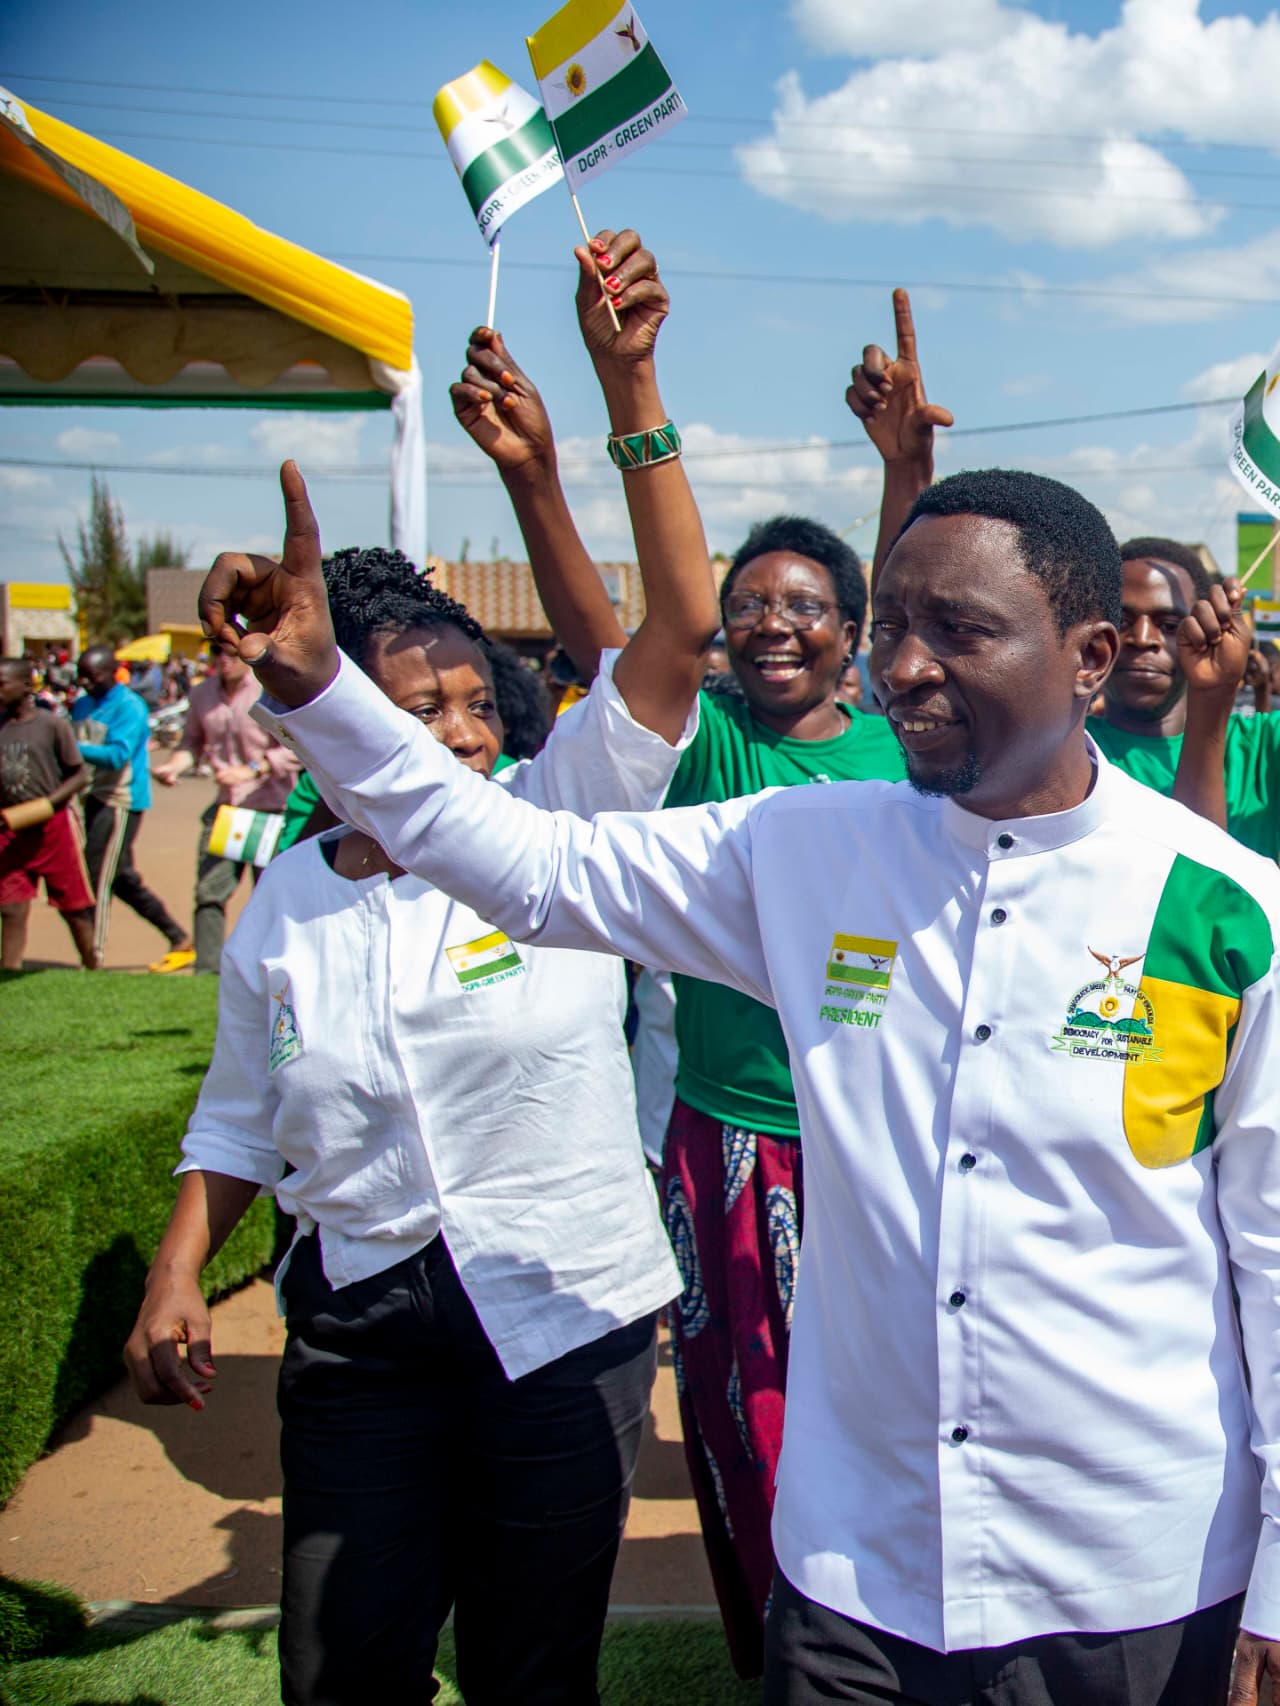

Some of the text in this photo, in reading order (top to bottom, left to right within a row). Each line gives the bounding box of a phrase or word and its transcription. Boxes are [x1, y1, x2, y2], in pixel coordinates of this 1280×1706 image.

[578, 144, 608, 173] DGPR
[615, 117, 654, 149] GREEN
[820, 1004, 882, 1028] PRESIDENT
[1101, 1037, 1113, 1046] FOR
[1072, 1046, 1140, 1062] DEVELOPMENT
